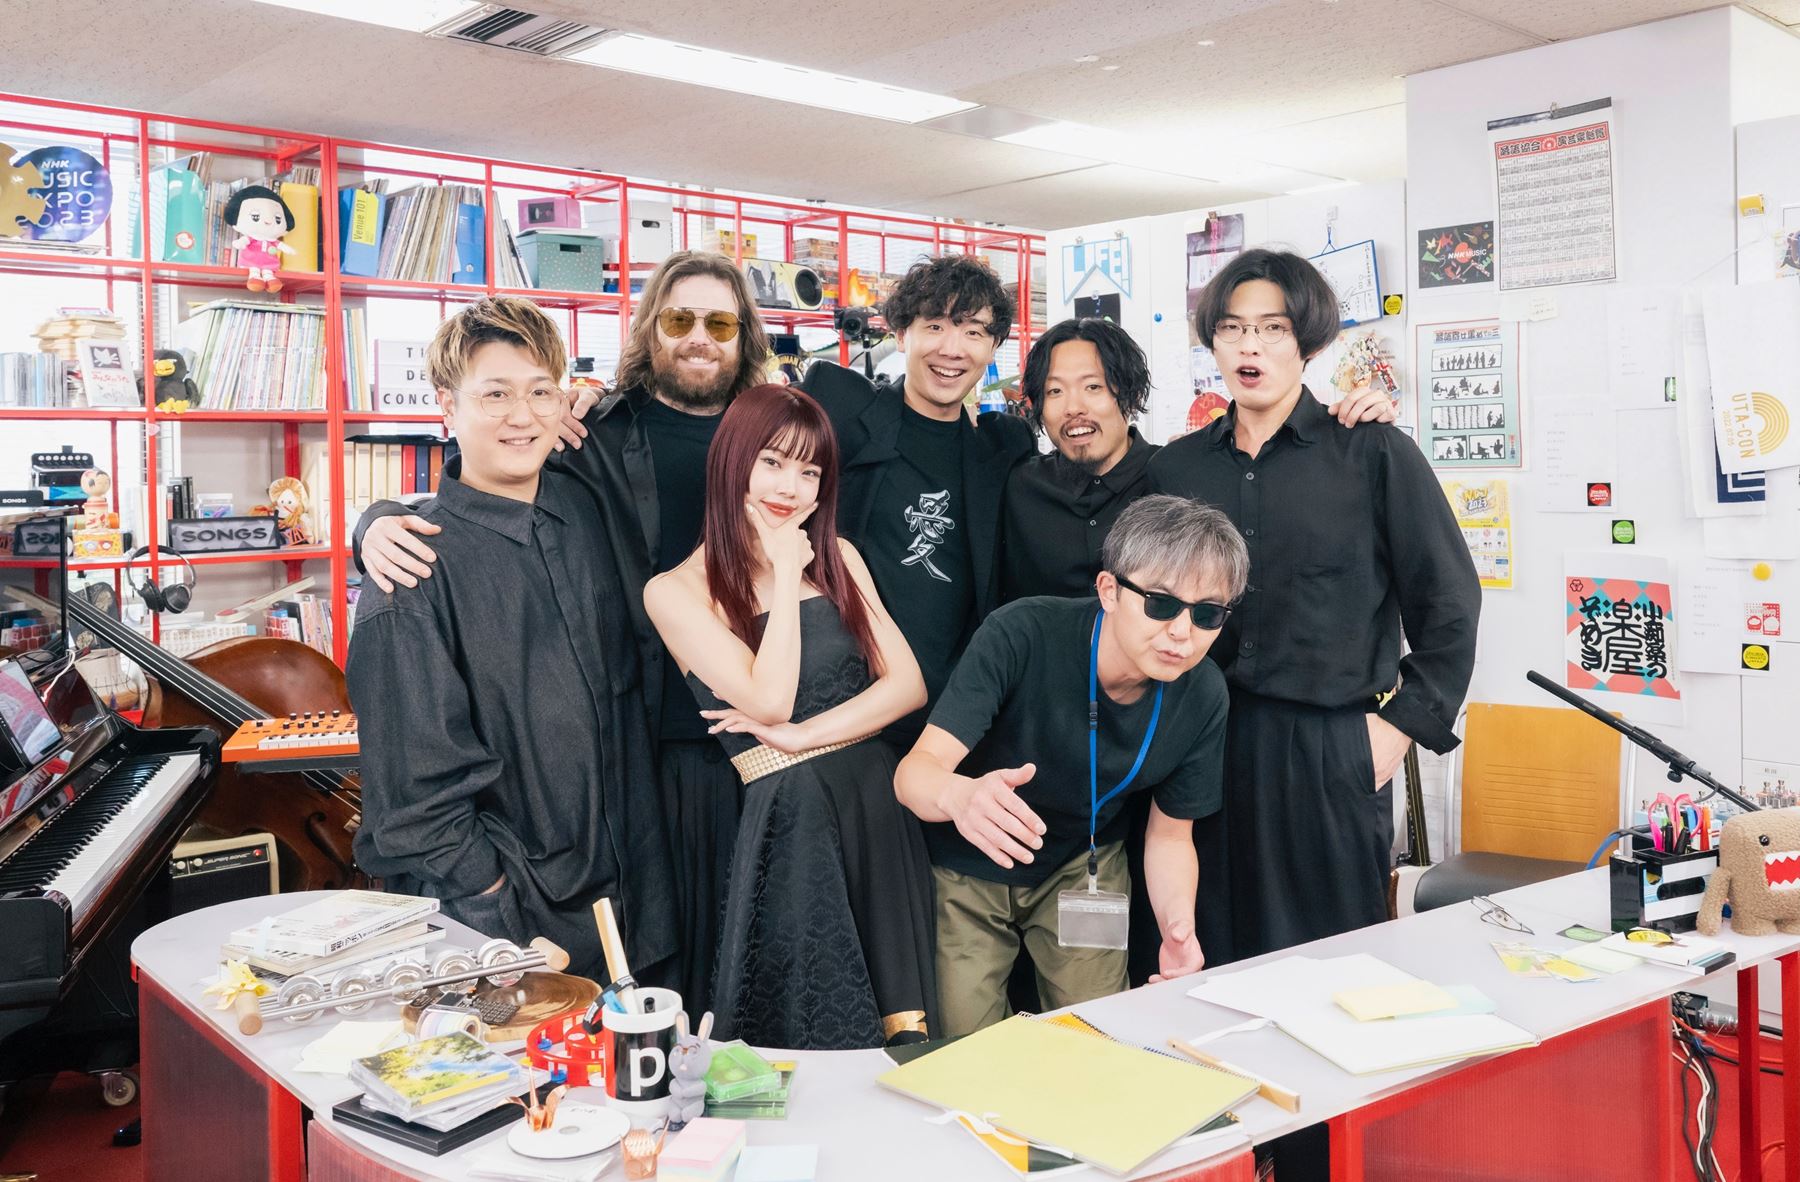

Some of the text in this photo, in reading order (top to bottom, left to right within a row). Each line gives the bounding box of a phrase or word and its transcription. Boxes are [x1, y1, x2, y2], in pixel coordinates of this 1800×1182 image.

[41, 160, 70, 168] NHK
[44, 170, 93, 188] USIC
[36, 191, 95, 208] XPO
[353, 199, 367, 240] Venue 101
[1448, 249, 1487, 260] NHK MUSIC
[406, 347, 424, 358] TI
[406, 369, 426, 381] DE
[1732, 393, 1755, 458] UTA-CON
[181, 527, 268, 543] SONGS
[1602, 597, 1646, 677] 楽屋
[630, 1046, 666, 1097] p
